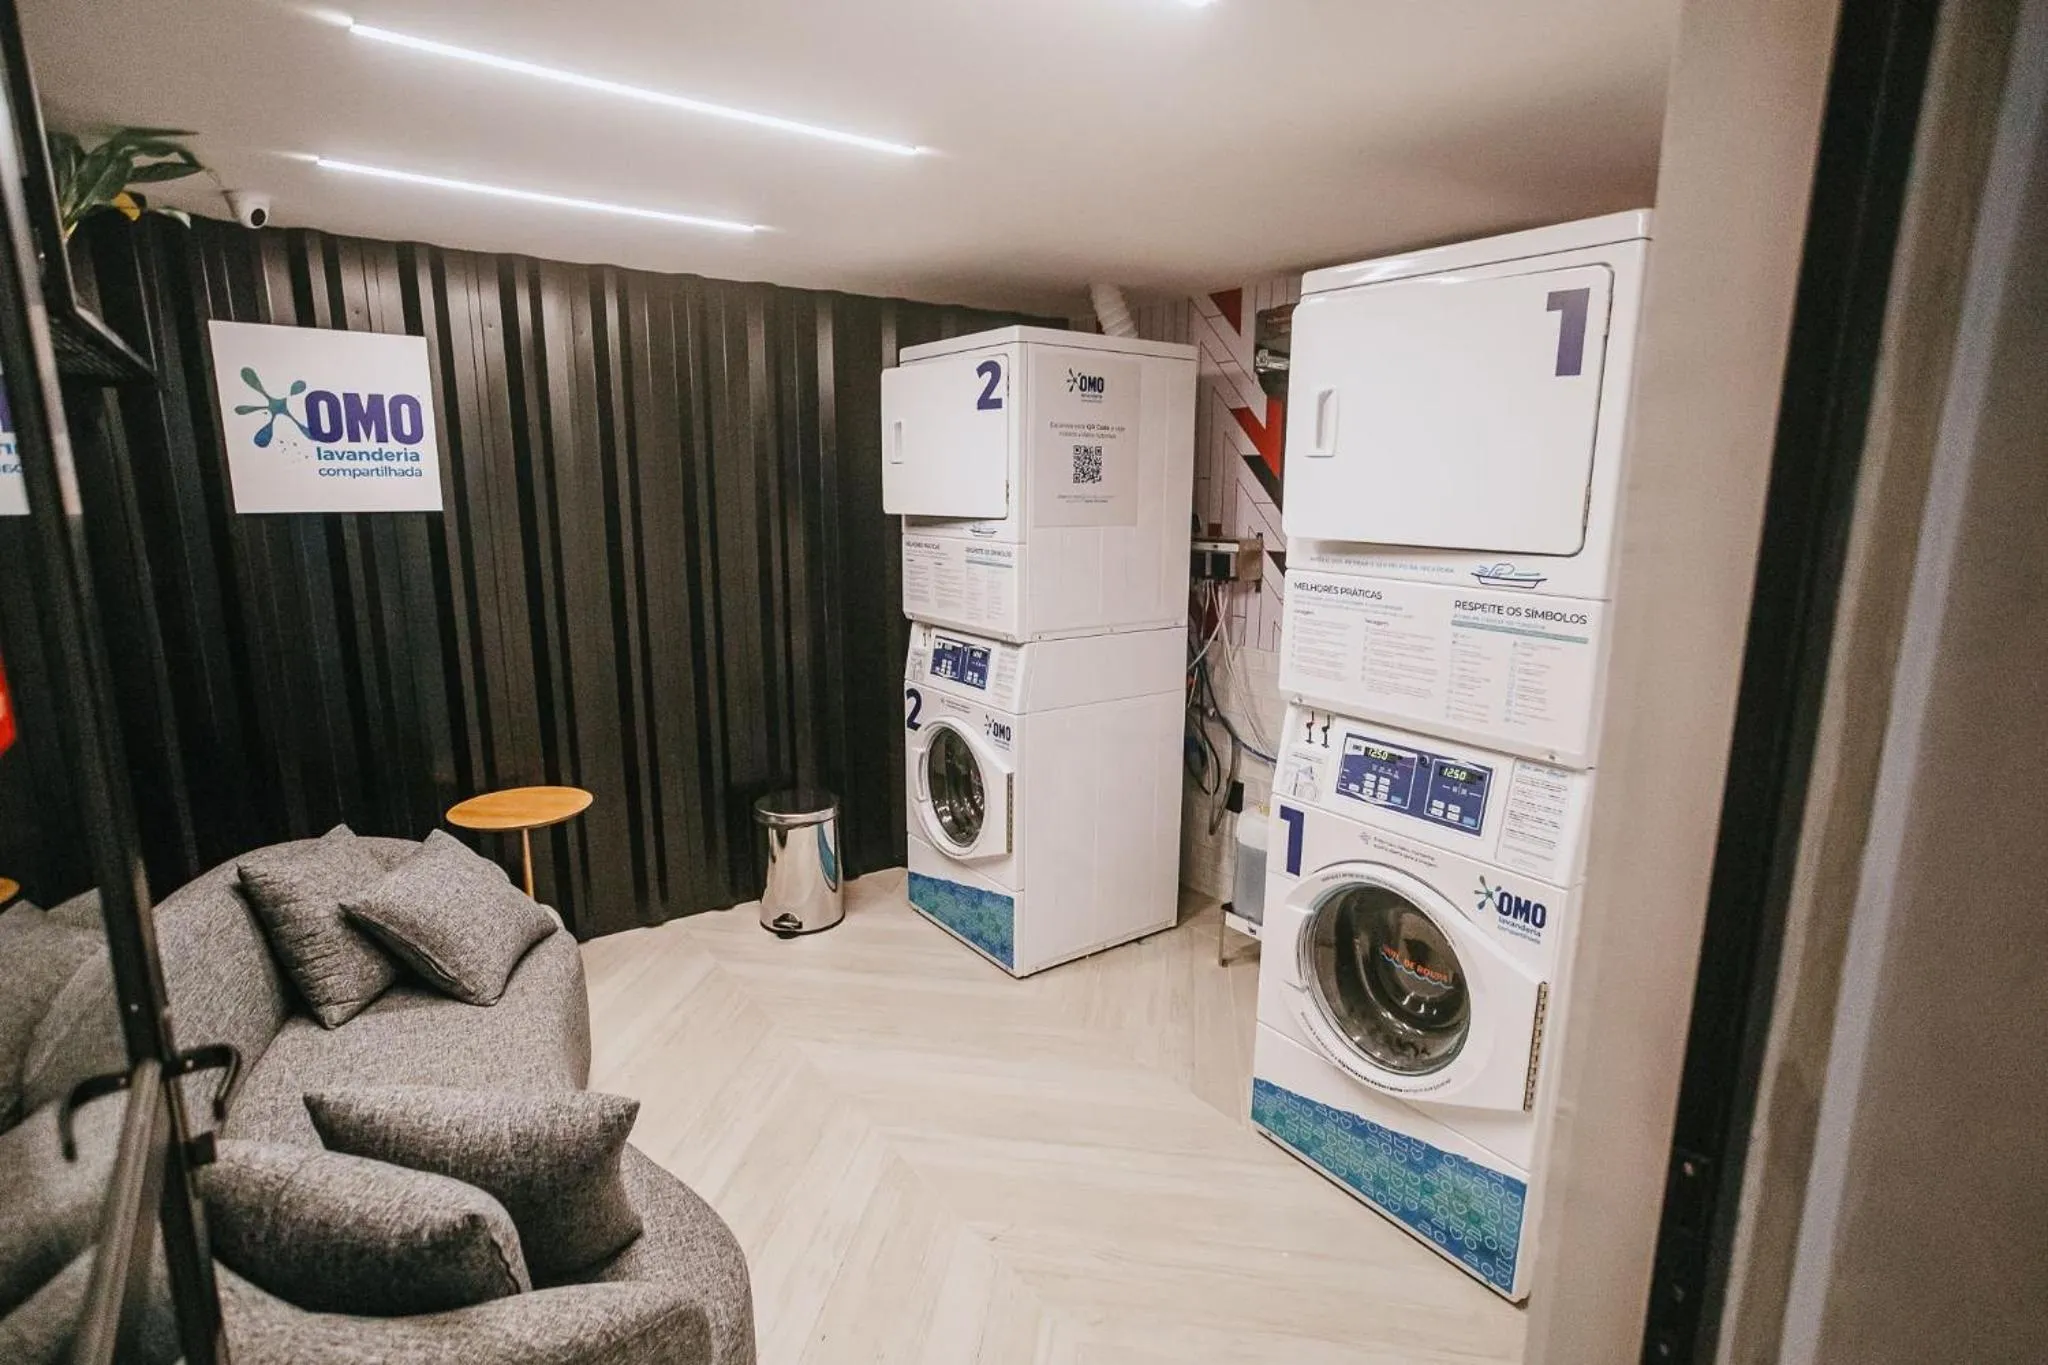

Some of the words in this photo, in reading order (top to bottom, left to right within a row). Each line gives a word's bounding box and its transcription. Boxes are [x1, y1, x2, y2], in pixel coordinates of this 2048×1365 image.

[1546, 287, 1590, 377] 1
[976, 360, 1003, 411] 2
[1080, 375, 1104, 393] OMO
[305, 390, 424, 445] OMO
[316, 446, 421, 462] lavanderia
[318, 465, 423, 479] compartilhada
[1294, 582, 1339, 595] MELHORES
[1454, 600, 1505, 615] RESPEITE
[1506, 605, 1522, 617] OS
[906, 687, 923, 731] 2
[993, 722, 1012, 741] OMO
[1443, 767, 1467, 781] 1250
[1279, 804, 1304, 877] 1
[1498, 891, 1547, 929] OMO
[1498, 915, 1542, 937] lavanderia
